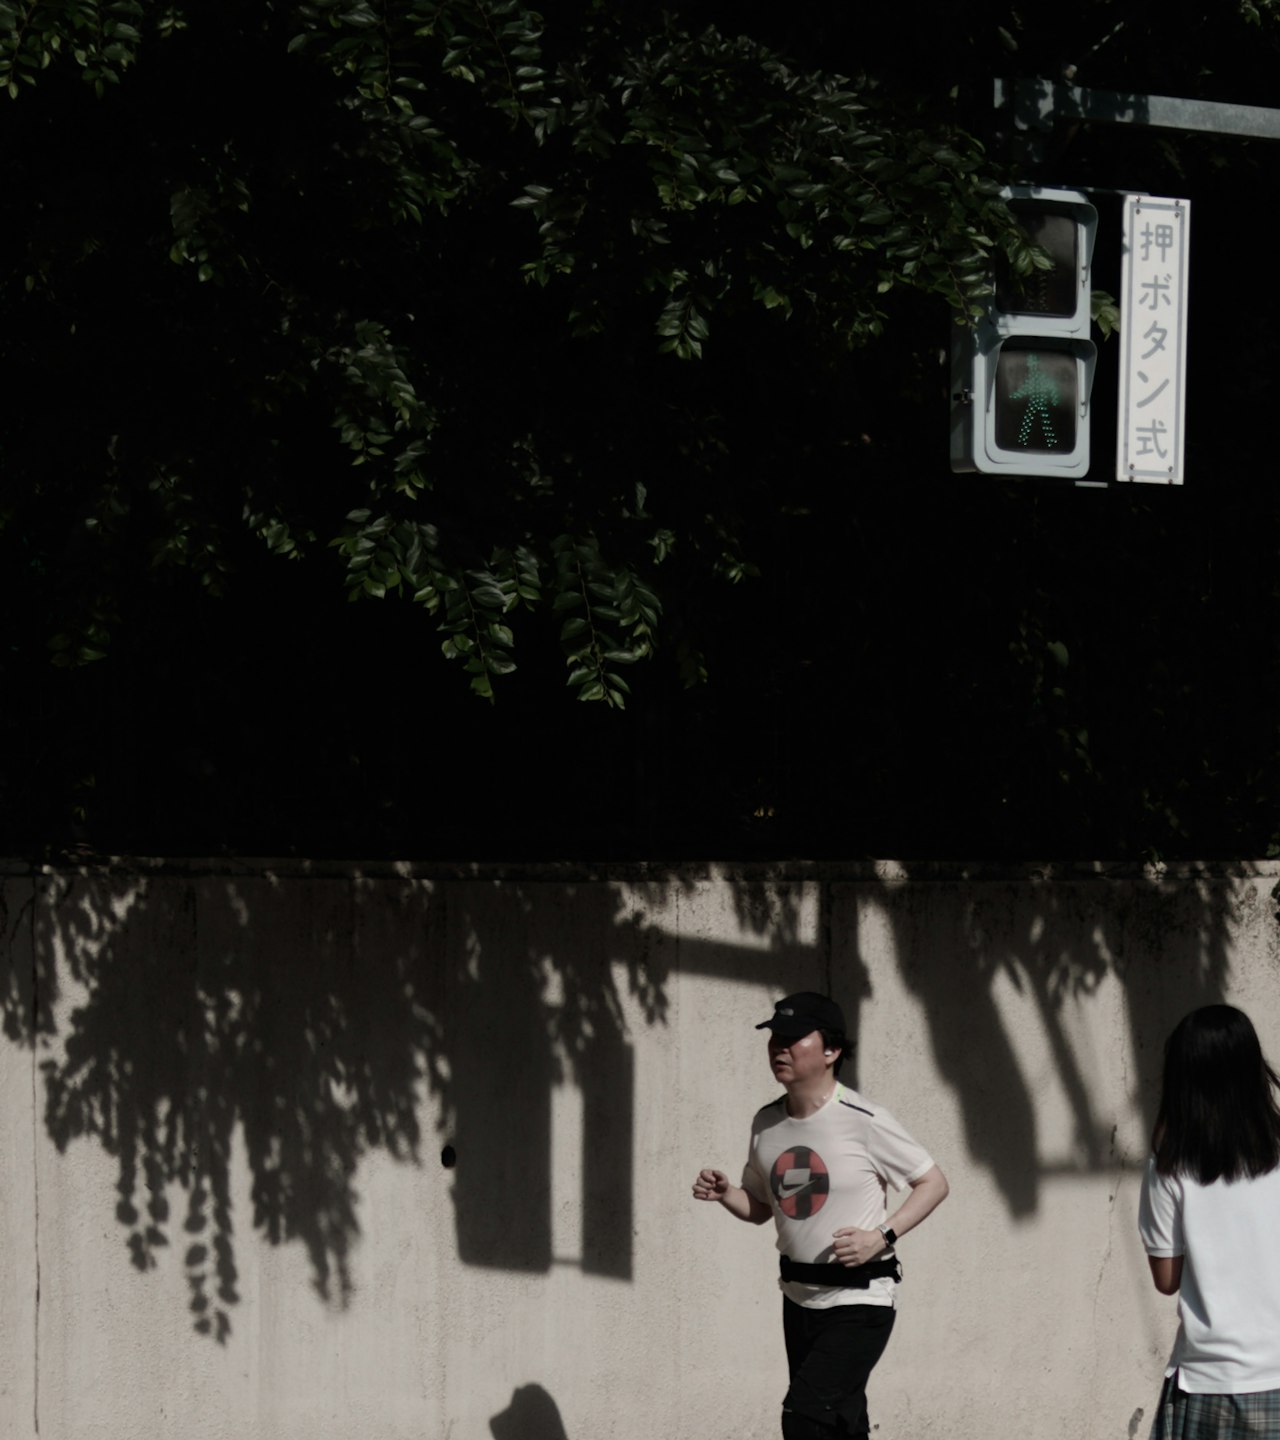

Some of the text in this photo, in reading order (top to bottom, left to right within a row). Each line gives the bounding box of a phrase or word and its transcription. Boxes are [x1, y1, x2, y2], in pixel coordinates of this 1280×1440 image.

[1136, 222, 1174, 459] 押ボタン式
